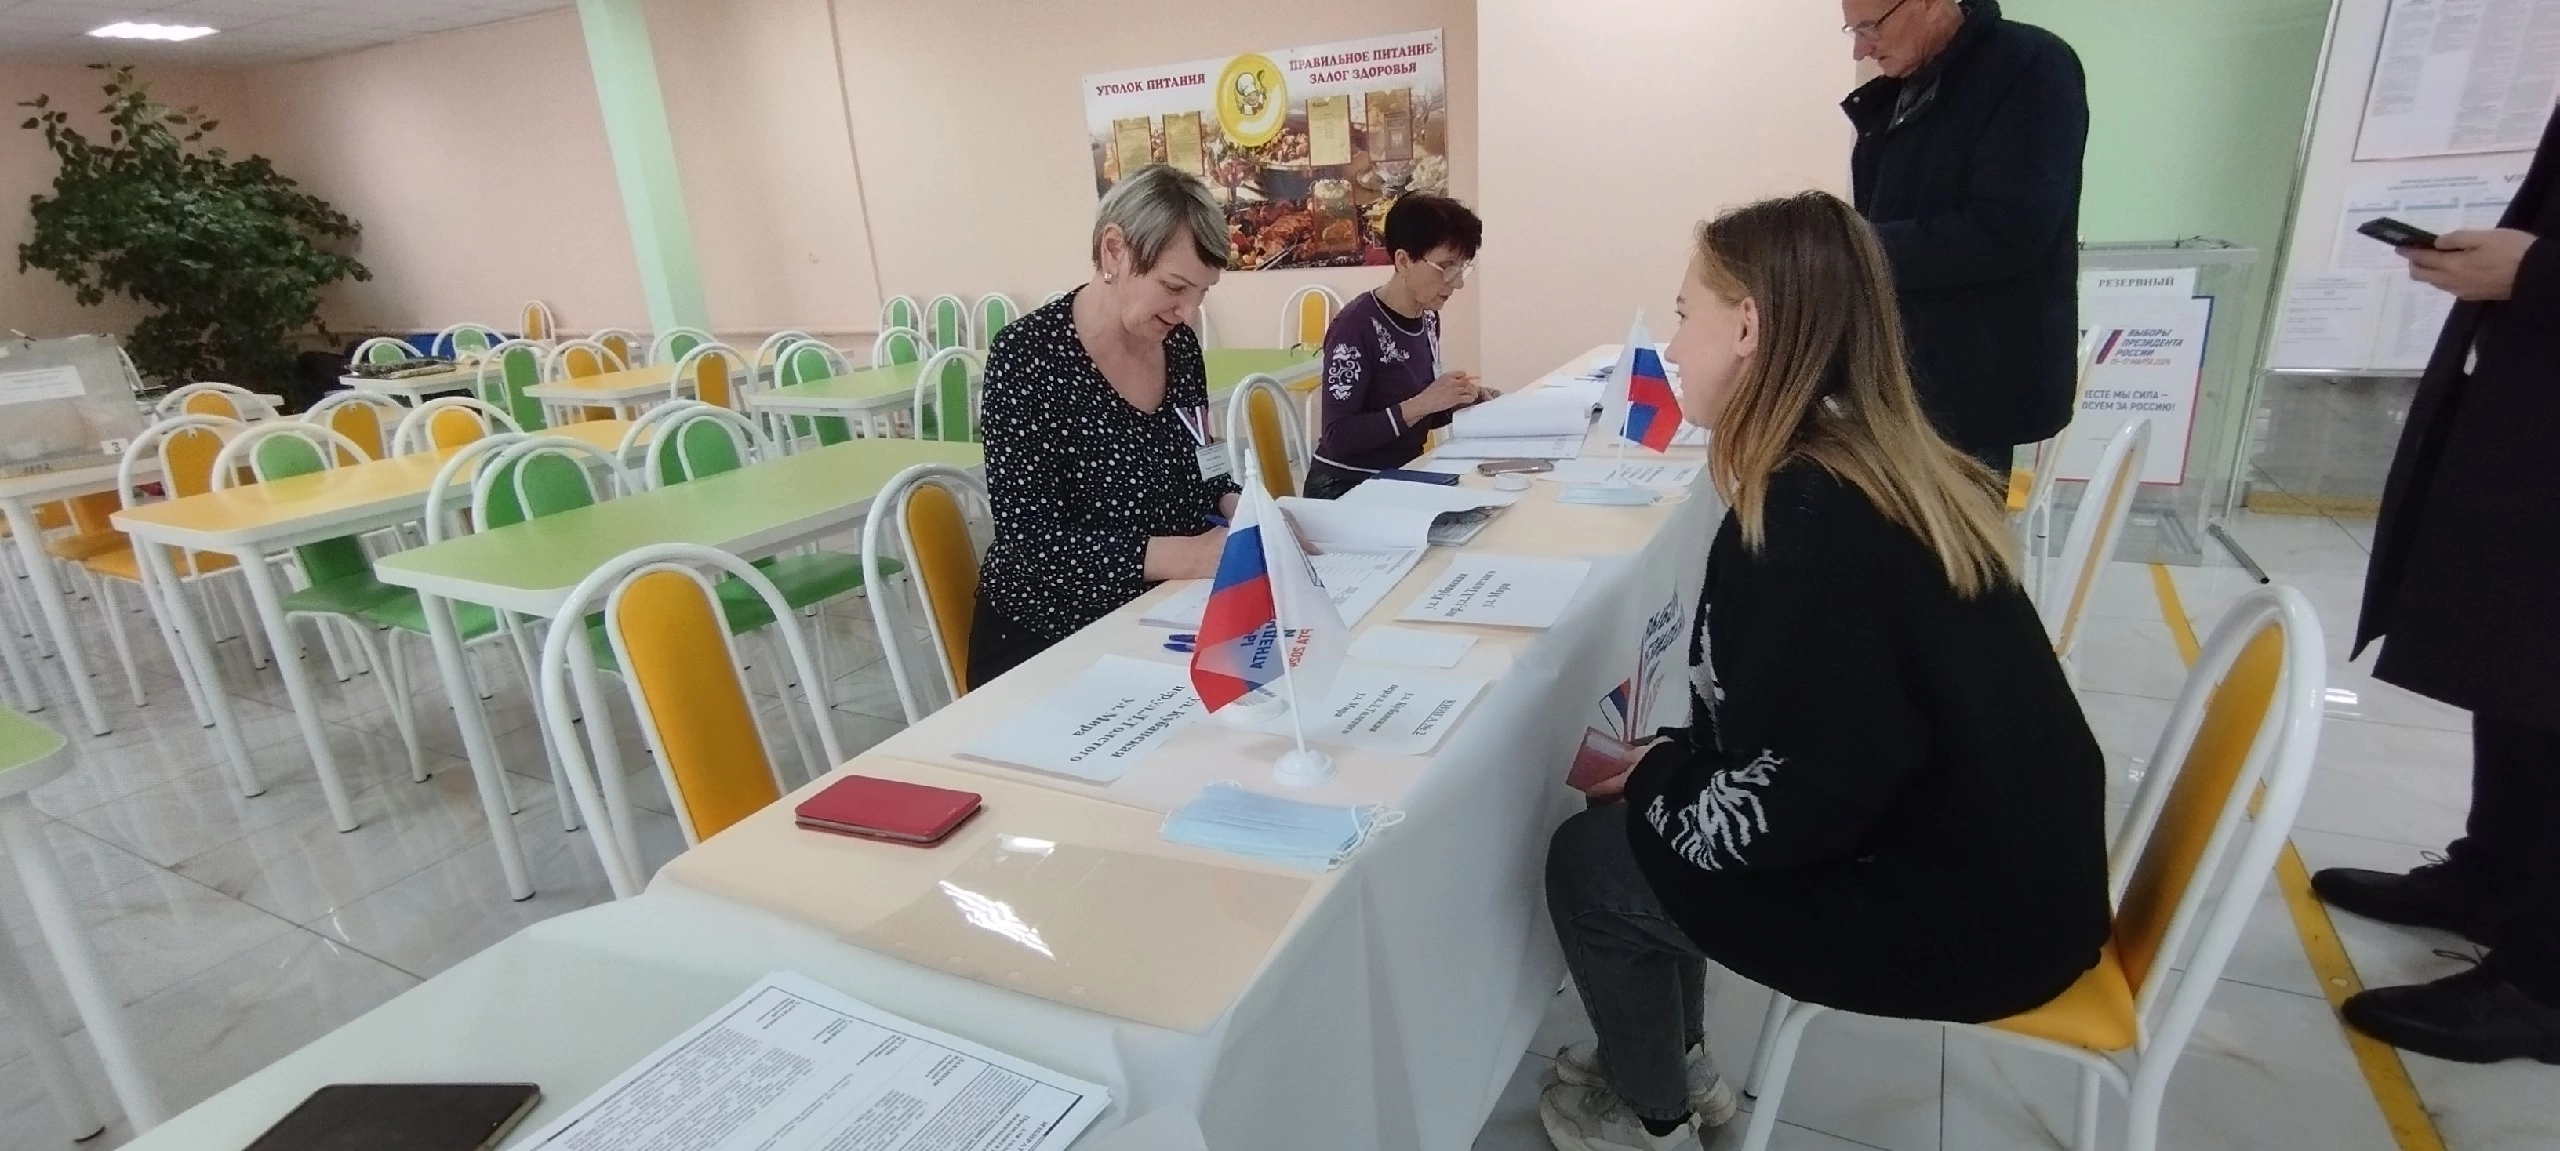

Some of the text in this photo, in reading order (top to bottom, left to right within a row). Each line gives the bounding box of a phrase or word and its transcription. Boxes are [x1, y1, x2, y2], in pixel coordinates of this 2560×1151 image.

[1289, 51, 1370, 71] ПРАВИЛЬНОЕ
[1309, 62, 1417, 84] ЗАЛОГ ЗДОРОВЬЯ
[1096, 73, 1205, 96] УГОЛОК ПИТАНИЯ
[2099, 276, 2174, 287] РЕЗЕРВНЫЙ
[2127, 329, 2172, 337] ВЫБОРЫ
[2121, 338, 2183, 347] ПРЕЗИДЕНТА
[2115, 349, 2154, 357] РОССИИ
[2085, 390, 2111, 398] ЕСТЕ
[2113, 390, 2130, 399] МЫ
[2133, 390, 2159, 399] СИЛА
[2082, 401, 2175, 411] ОСУЕМ ЗА РОССИЮ!
[1072, 698, 1136, 736] ул. Мира
[1111, 711, 1185, 758] Кубанская
